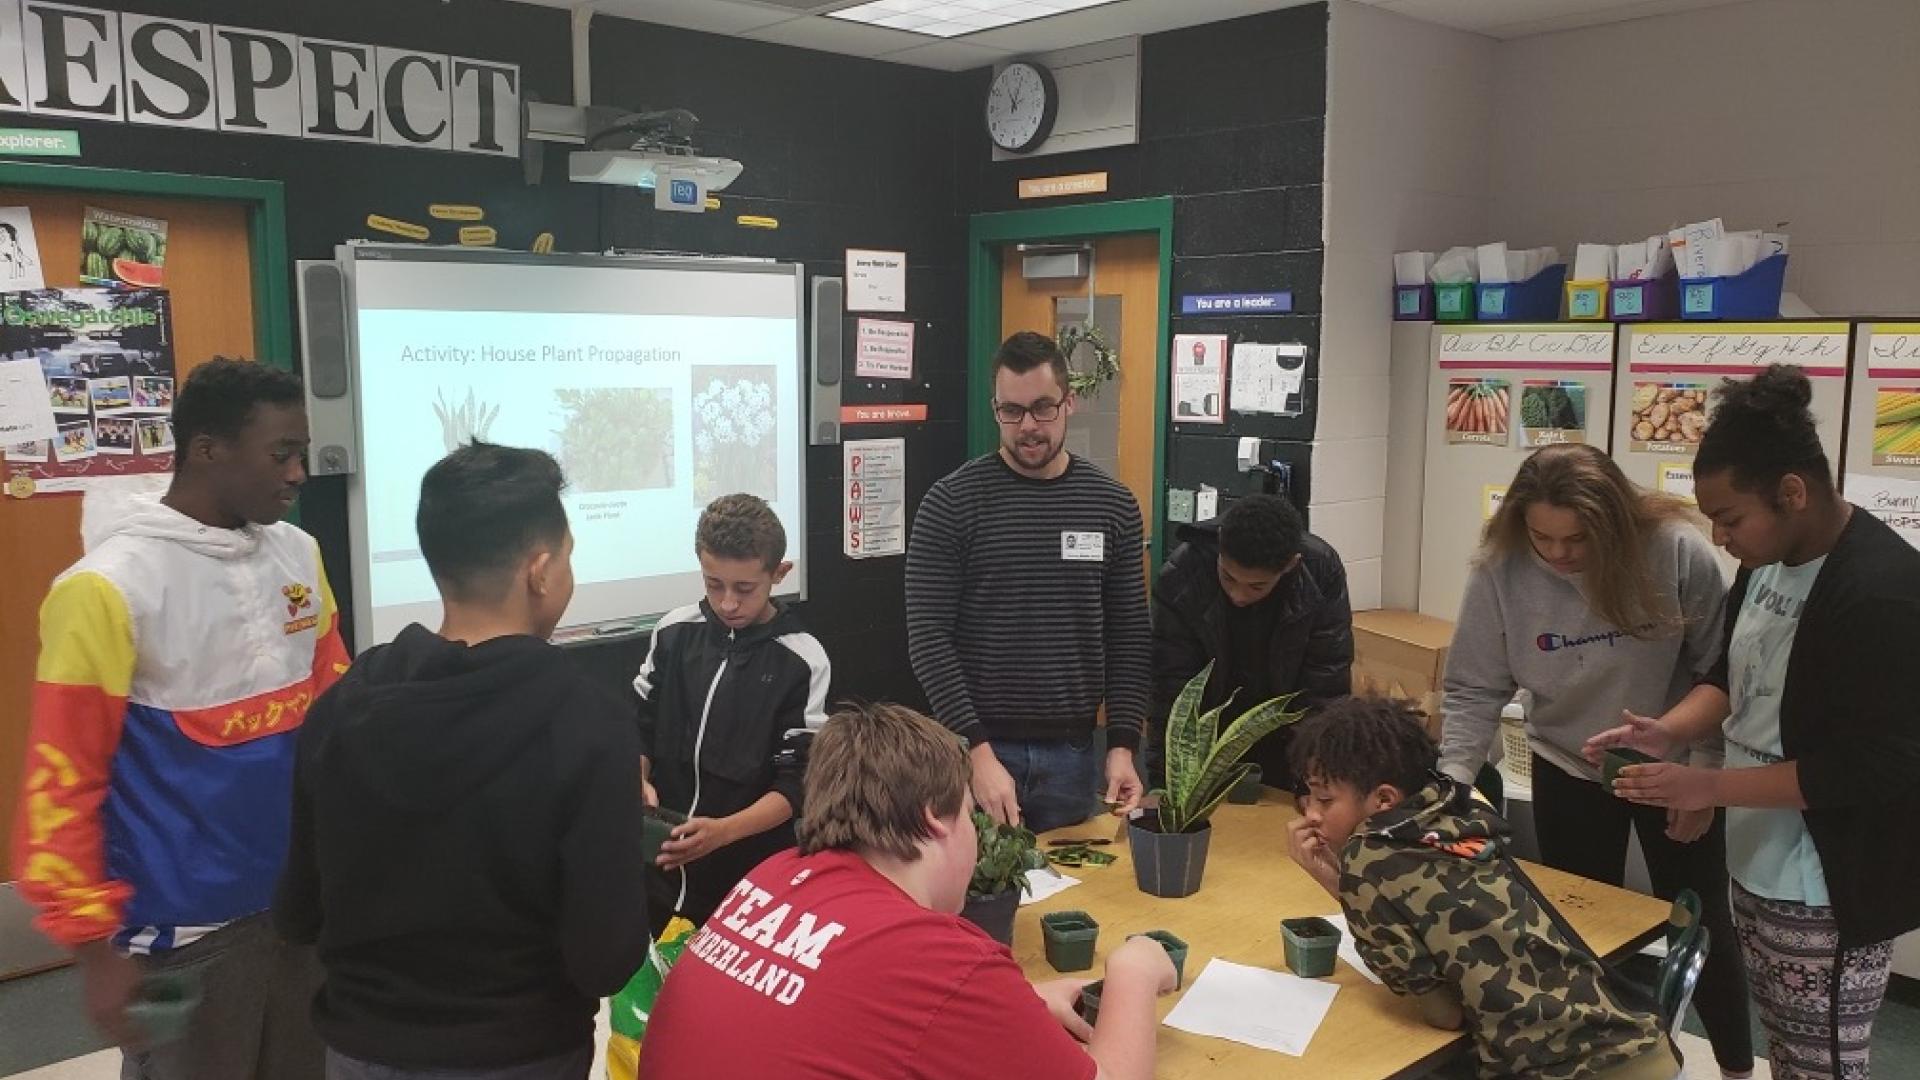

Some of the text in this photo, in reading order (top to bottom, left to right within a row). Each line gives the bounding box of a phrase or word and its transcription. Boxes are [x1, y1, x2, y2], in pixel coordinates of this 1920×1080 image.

[0, 5, 515, 152] ESPECT
[1196, 296, 1277, 309] You are a leader.
[401, 344, 681, 365] Activity: House Plant Propagation
[713, 878, 847, 970] TEAM
